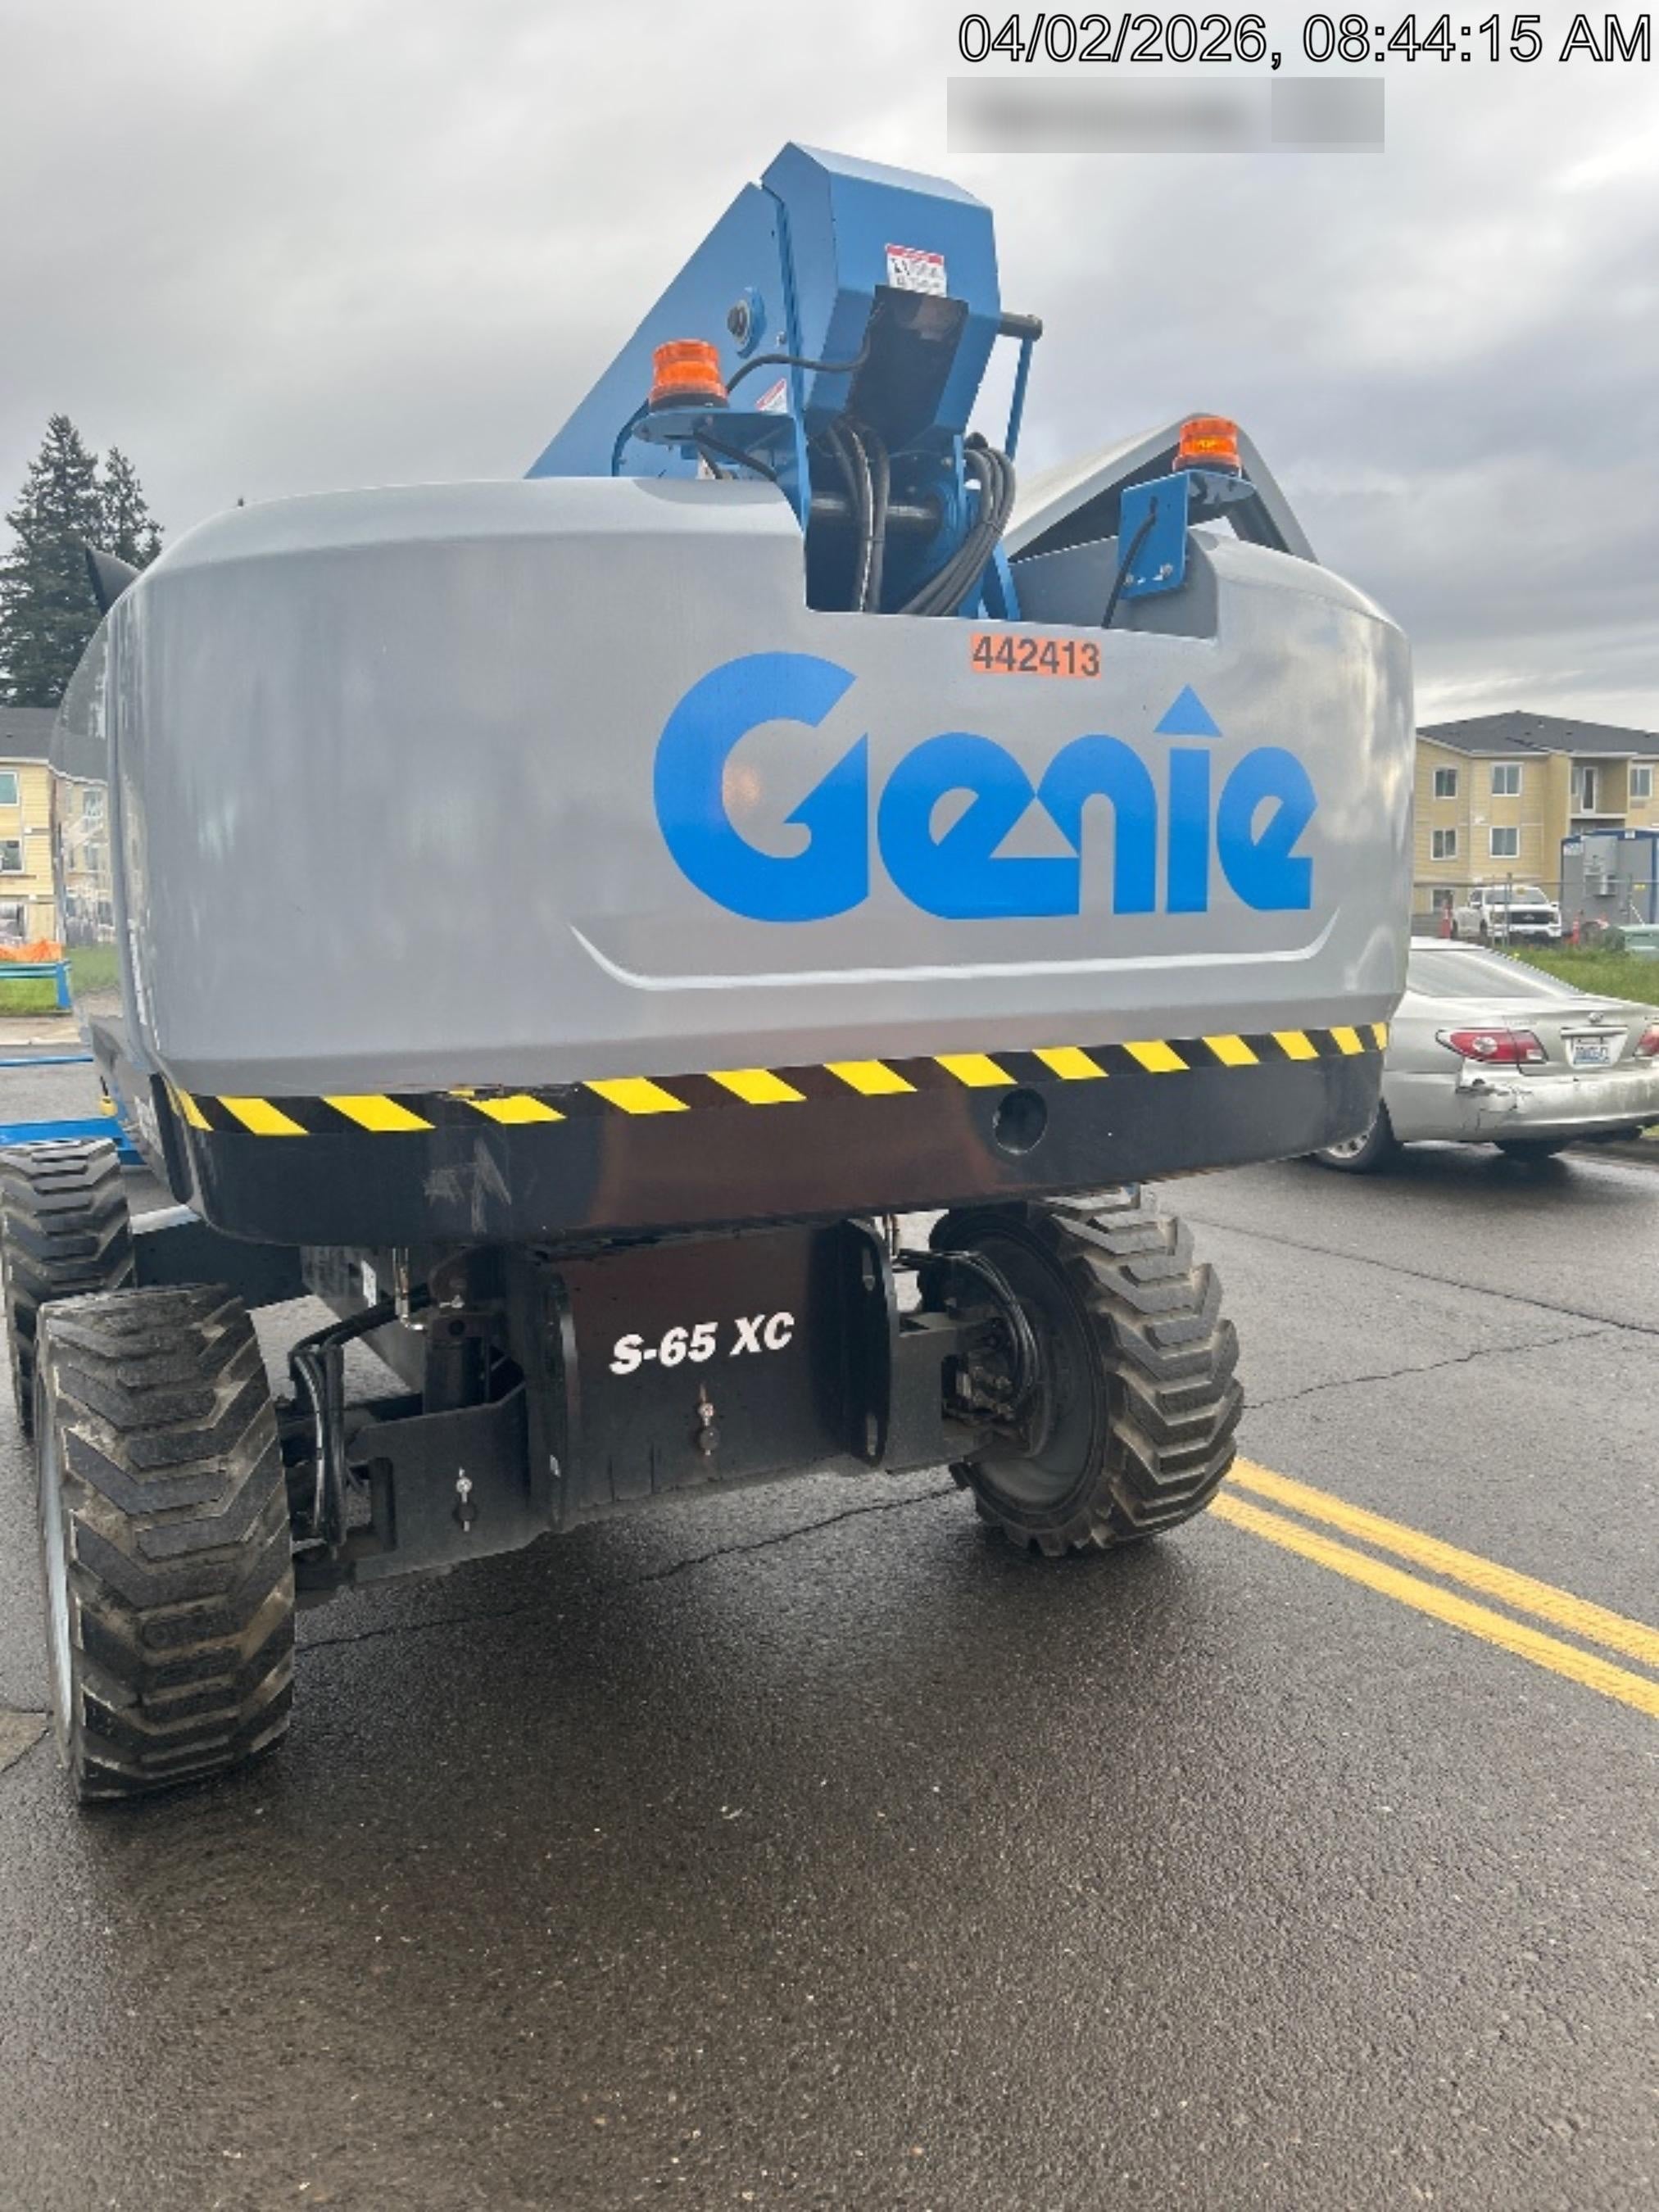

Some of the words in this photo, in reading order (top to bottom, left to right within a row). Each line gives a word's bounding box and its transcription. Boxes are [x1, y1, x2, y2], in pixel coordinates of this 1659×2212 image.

[972, 636, 1099, 677] 442413
[653, 651, 1317, 922] Genie
[609, 1321, 718, 1375] S-65
[729, 1312, 795, 1357] XC
